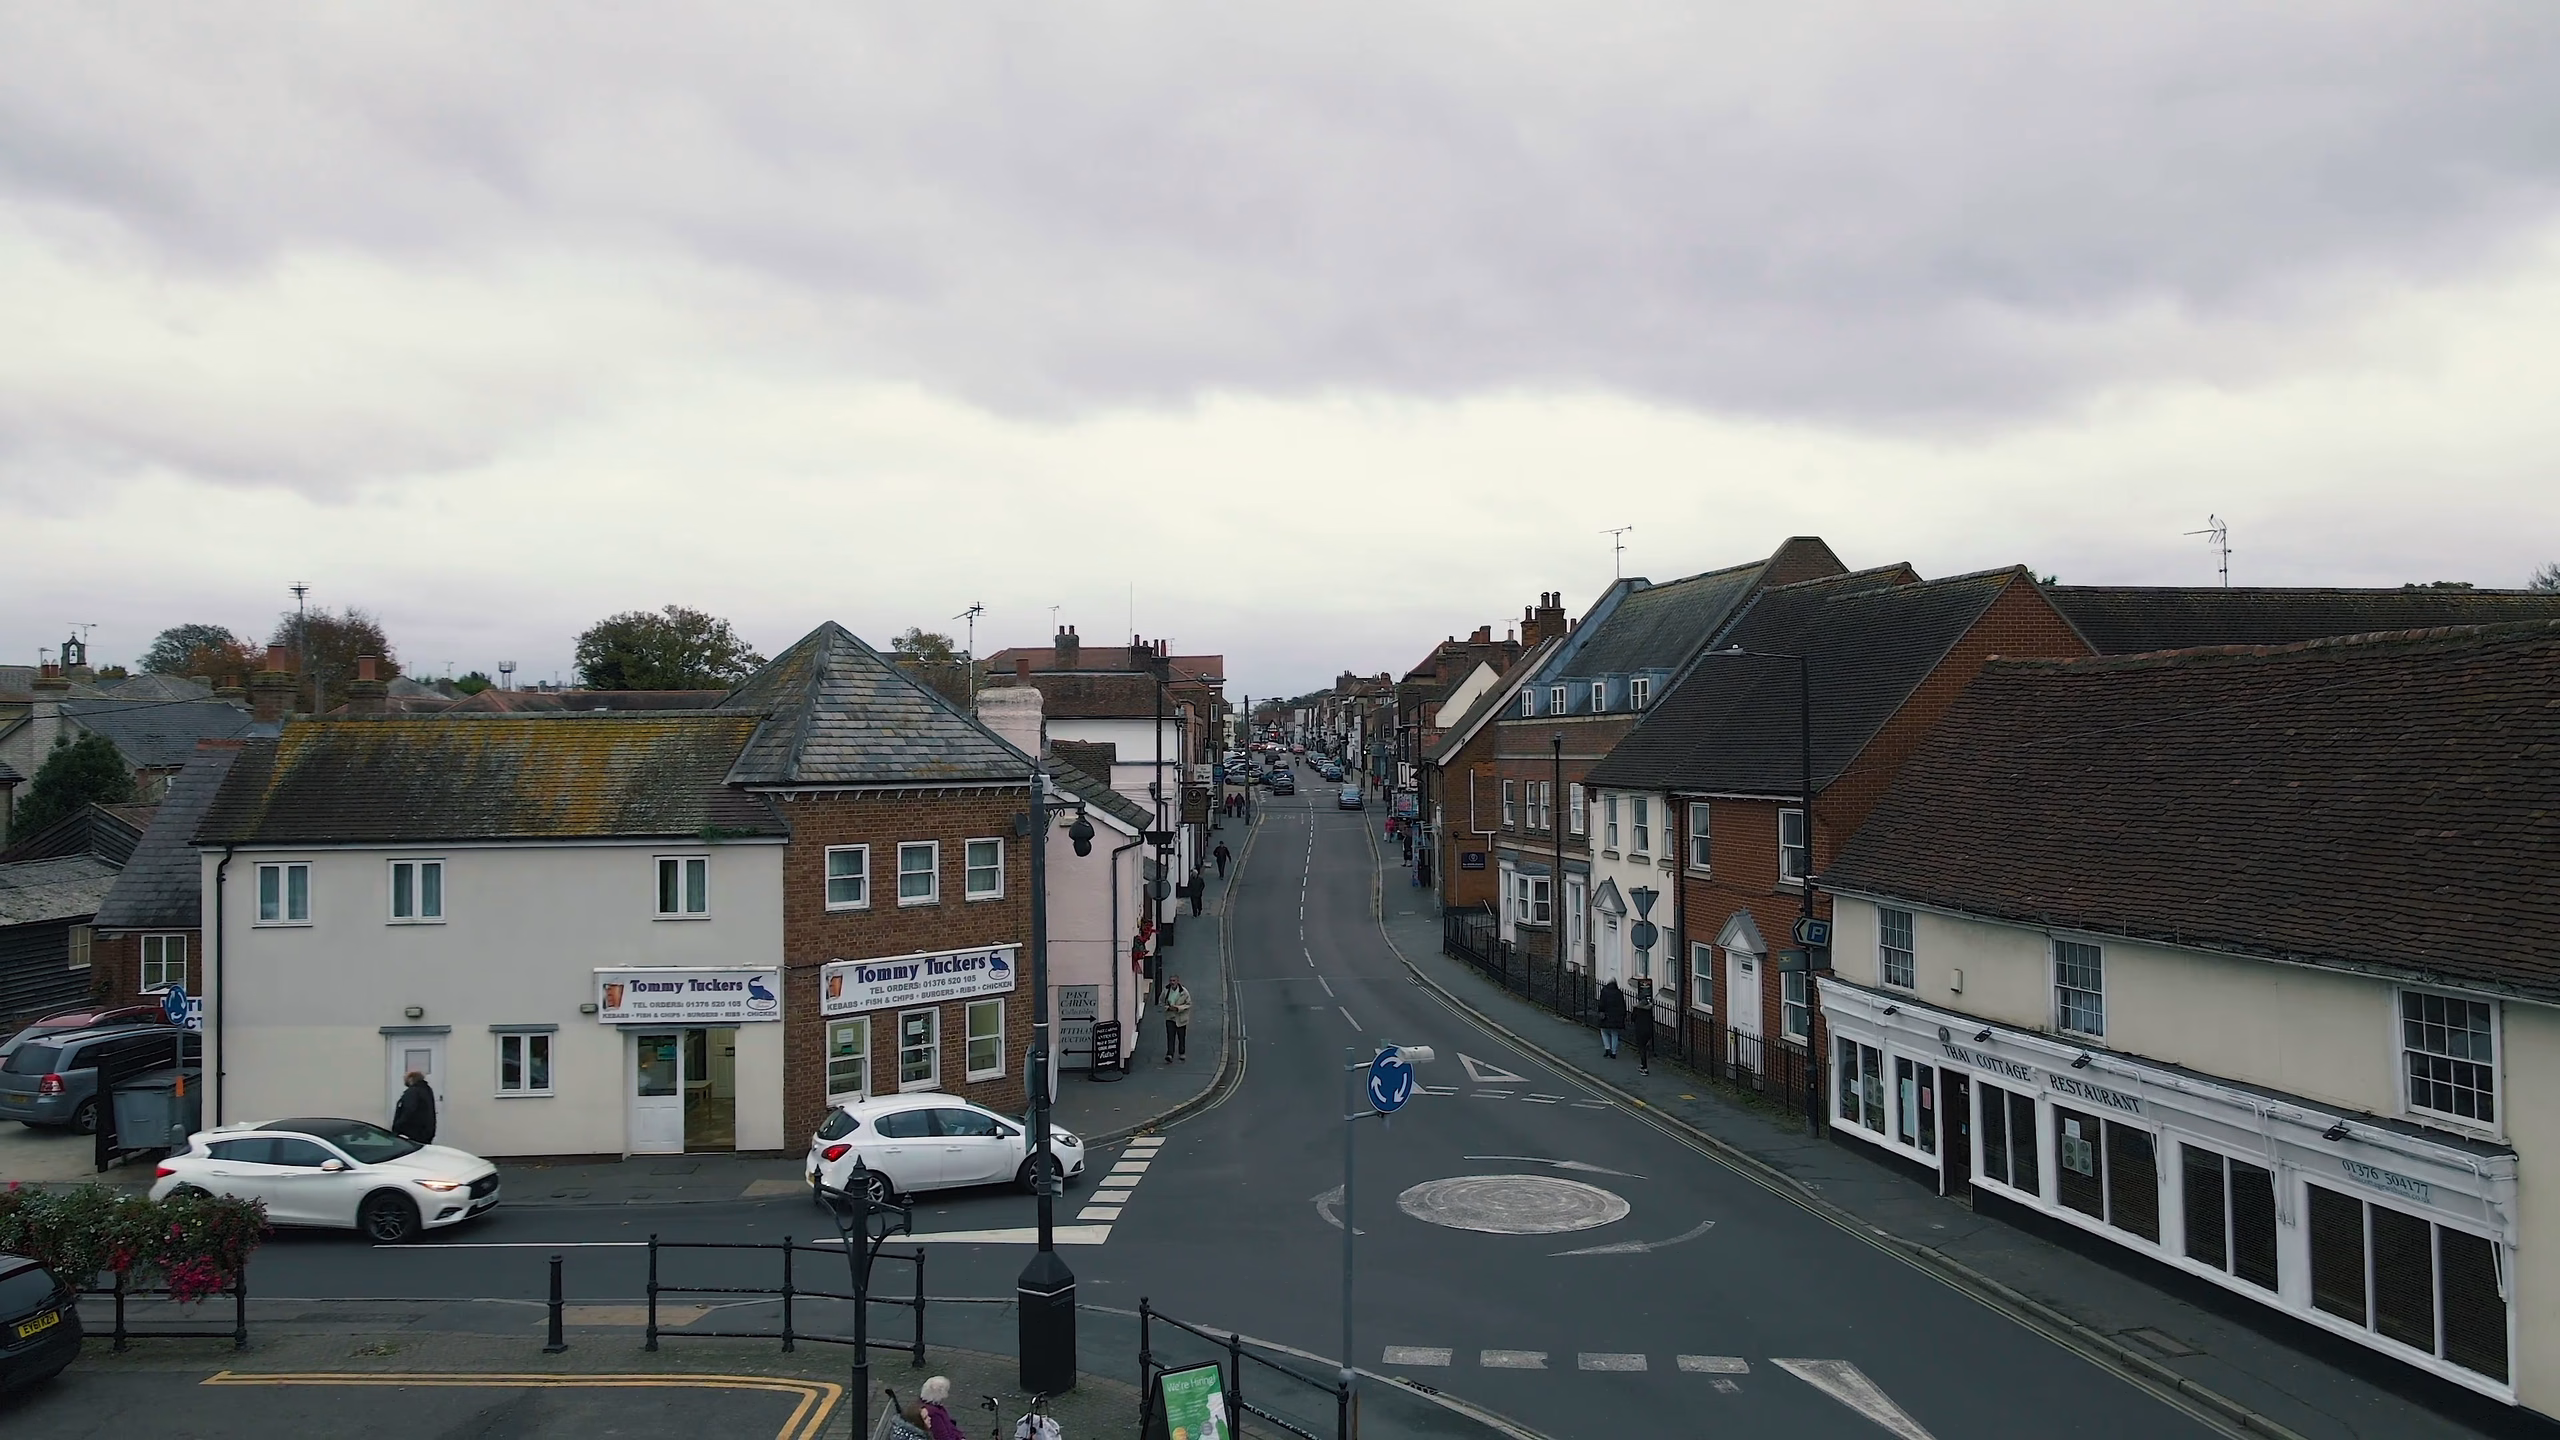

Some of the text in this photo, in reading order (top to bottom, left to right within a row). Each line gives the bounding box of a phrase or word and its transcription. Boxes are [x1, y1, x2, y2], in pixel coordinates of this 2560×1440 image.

[1811, 926, 1824, 940] P
[855, 956, 986, 984] Tommy Tuckers
[630, 979, 743, 994] Tommy Tuckers
[870, 975, 977, 995] TEL ORDERS: 01376 520 105
[827, 1001, 858, 1011] KEBABS
[865, 997, 883, 1006] FISH
[892, 993, 914, 1003] CHIPS
[921, 989, 954, 1000] BURGERS
[959, 985, 976, 994] RIBS
[982, 980, 1012, 991] CHICKEN
[1060, 999, 1097, 1007] CARING
[1066, 991, 1090, 999] PAST
[1942, 1043, 2140, 1114] THAI COTTAGE RESTAURANT
[2342, 1160, 2428, 1197] 01376 504177
[1166, 1374, 1216, 1392] We're Hiring!
